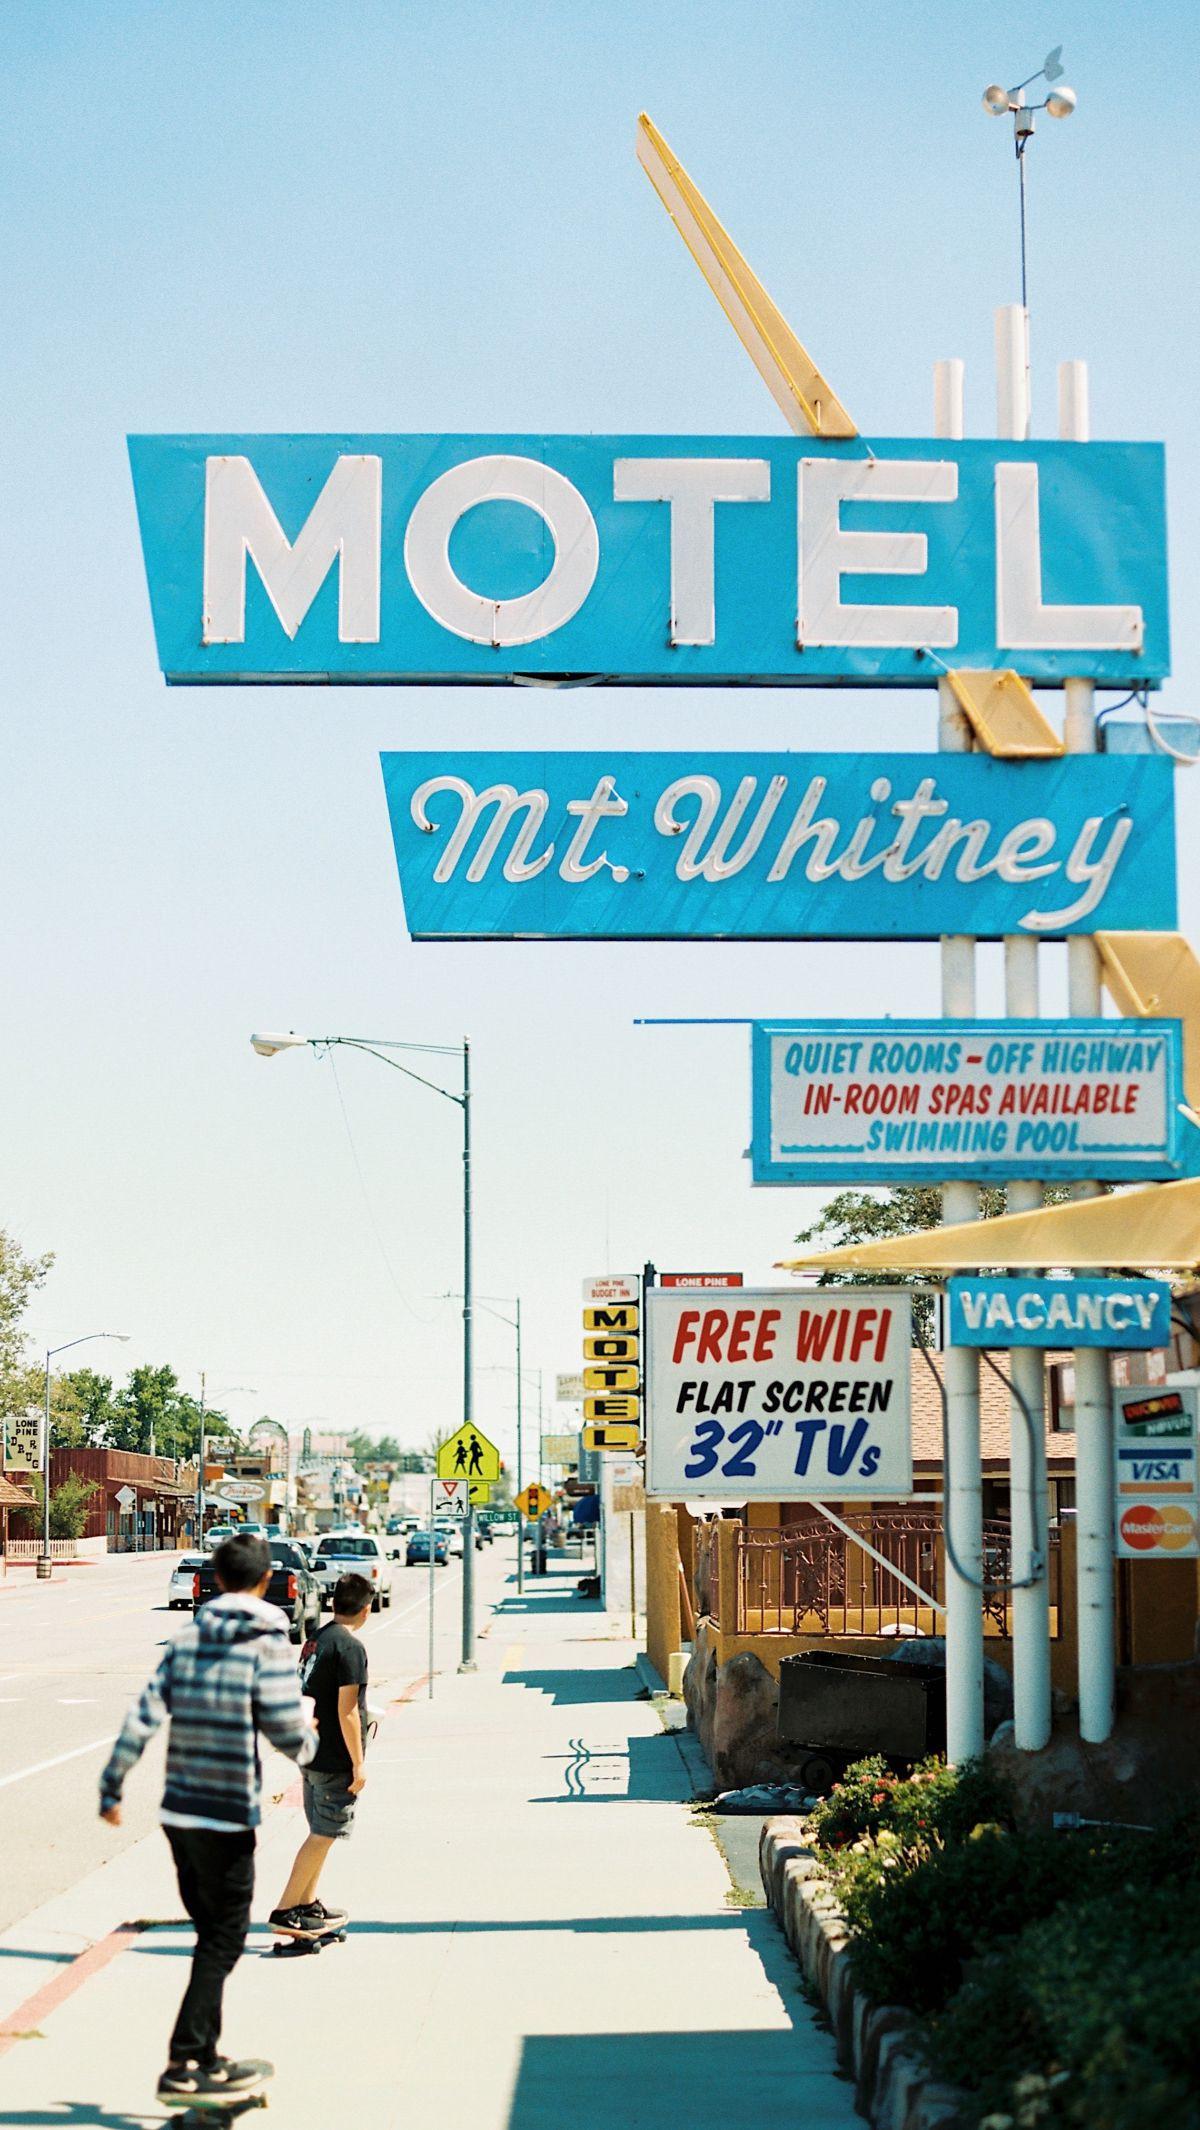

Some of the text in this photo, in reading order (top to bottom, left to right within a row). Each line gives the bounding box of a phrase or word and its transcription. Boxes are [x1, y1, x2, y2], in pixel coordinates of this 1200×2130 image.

[202, 454, 1146, 652] MOTEL
[409, 774, 1133, 932] Mt. Whitney
[785, 1042, 863, 1074] QUIET
[868, 1042, 961, 1073] ROOMS
[986, 1043, 1036, 1074] OFF
[1041, 1041, 1164, 1072] HIGHWAY
[803, 1083, 1140, 1116] IN-ROOM SPAS AVAILABLE
[866, 1120, 1081, 1153] SWIMMING POOL
[591, 1288, 631, 1298] BUDGET INN
[675, 1278, 728, 1287] LONE PINE
[959, 1291, 1160, 1330] VACANCY
[672, 1308, 893, 1364] FREE WIFI
[593, 1310, 628, 1446] MOTEL
[676, 1379, 894, 1414] FLAT SCREEN
[11, 1437, 38, 1468] DRUG
[684, 1418, 881, 1478] 32" TVs
[1132, 1462, 1180, 1480] VISA
[478, 1513, 504, 1521] WILLOW
[1122, 1522, 1194, 1535] MasterCard
